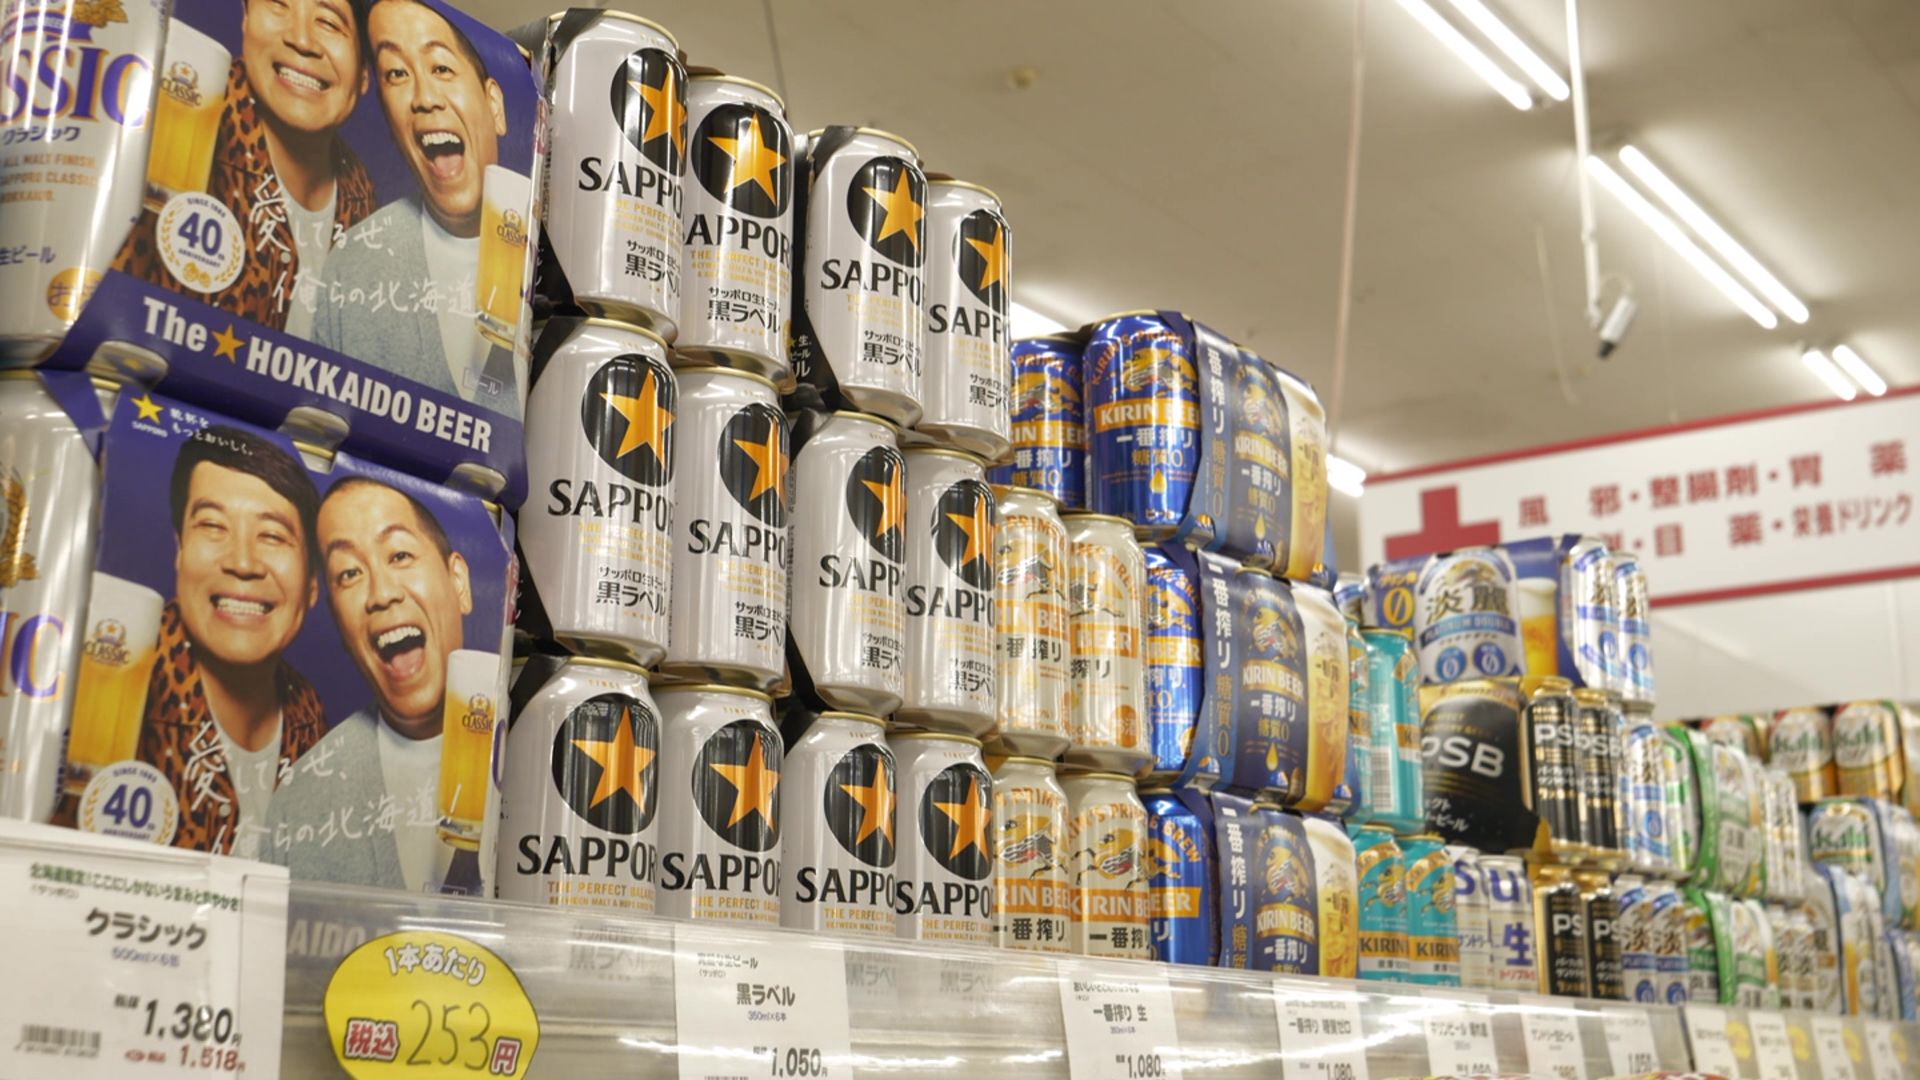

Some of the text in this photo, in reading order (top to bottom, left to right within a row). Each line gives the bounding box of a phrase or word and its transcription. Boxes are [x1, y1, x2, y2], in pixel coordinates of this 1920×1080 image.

[684, 214, 791, 270] APPOR
[707, 299, 781, 334] 黒ラベル
[144, 296, 491, 453] The HOKKAIDO BEER
[1101, 403, 1159, 426] KIRIN
[1116, 427, 1193, 449] 一番搾り
[548, 479, 673, 535] SAPPO
[1242, 665, 1276, 689] KIRIN
[1250, 694, 1297, 723] 一番搾り
[661, 852, 780, 897] SAPPO
[577, 882, 626, 897] PERFECT
[719, 897, 760, 910] PERFECT
[85, 907, 207, 950] クラシック
[1256, 909, 1315, 937] KIRIN BEER
[384, 942, 487, 987] 1本あたり
[1264, 938, 1308, 964] 一番搾り
[736, 982, 796, 1007] 黒ラベル
[1093, 1004, 1148, 1022] 一番搾り 生
[346, 999, 522, 1077] 税込 253 円
